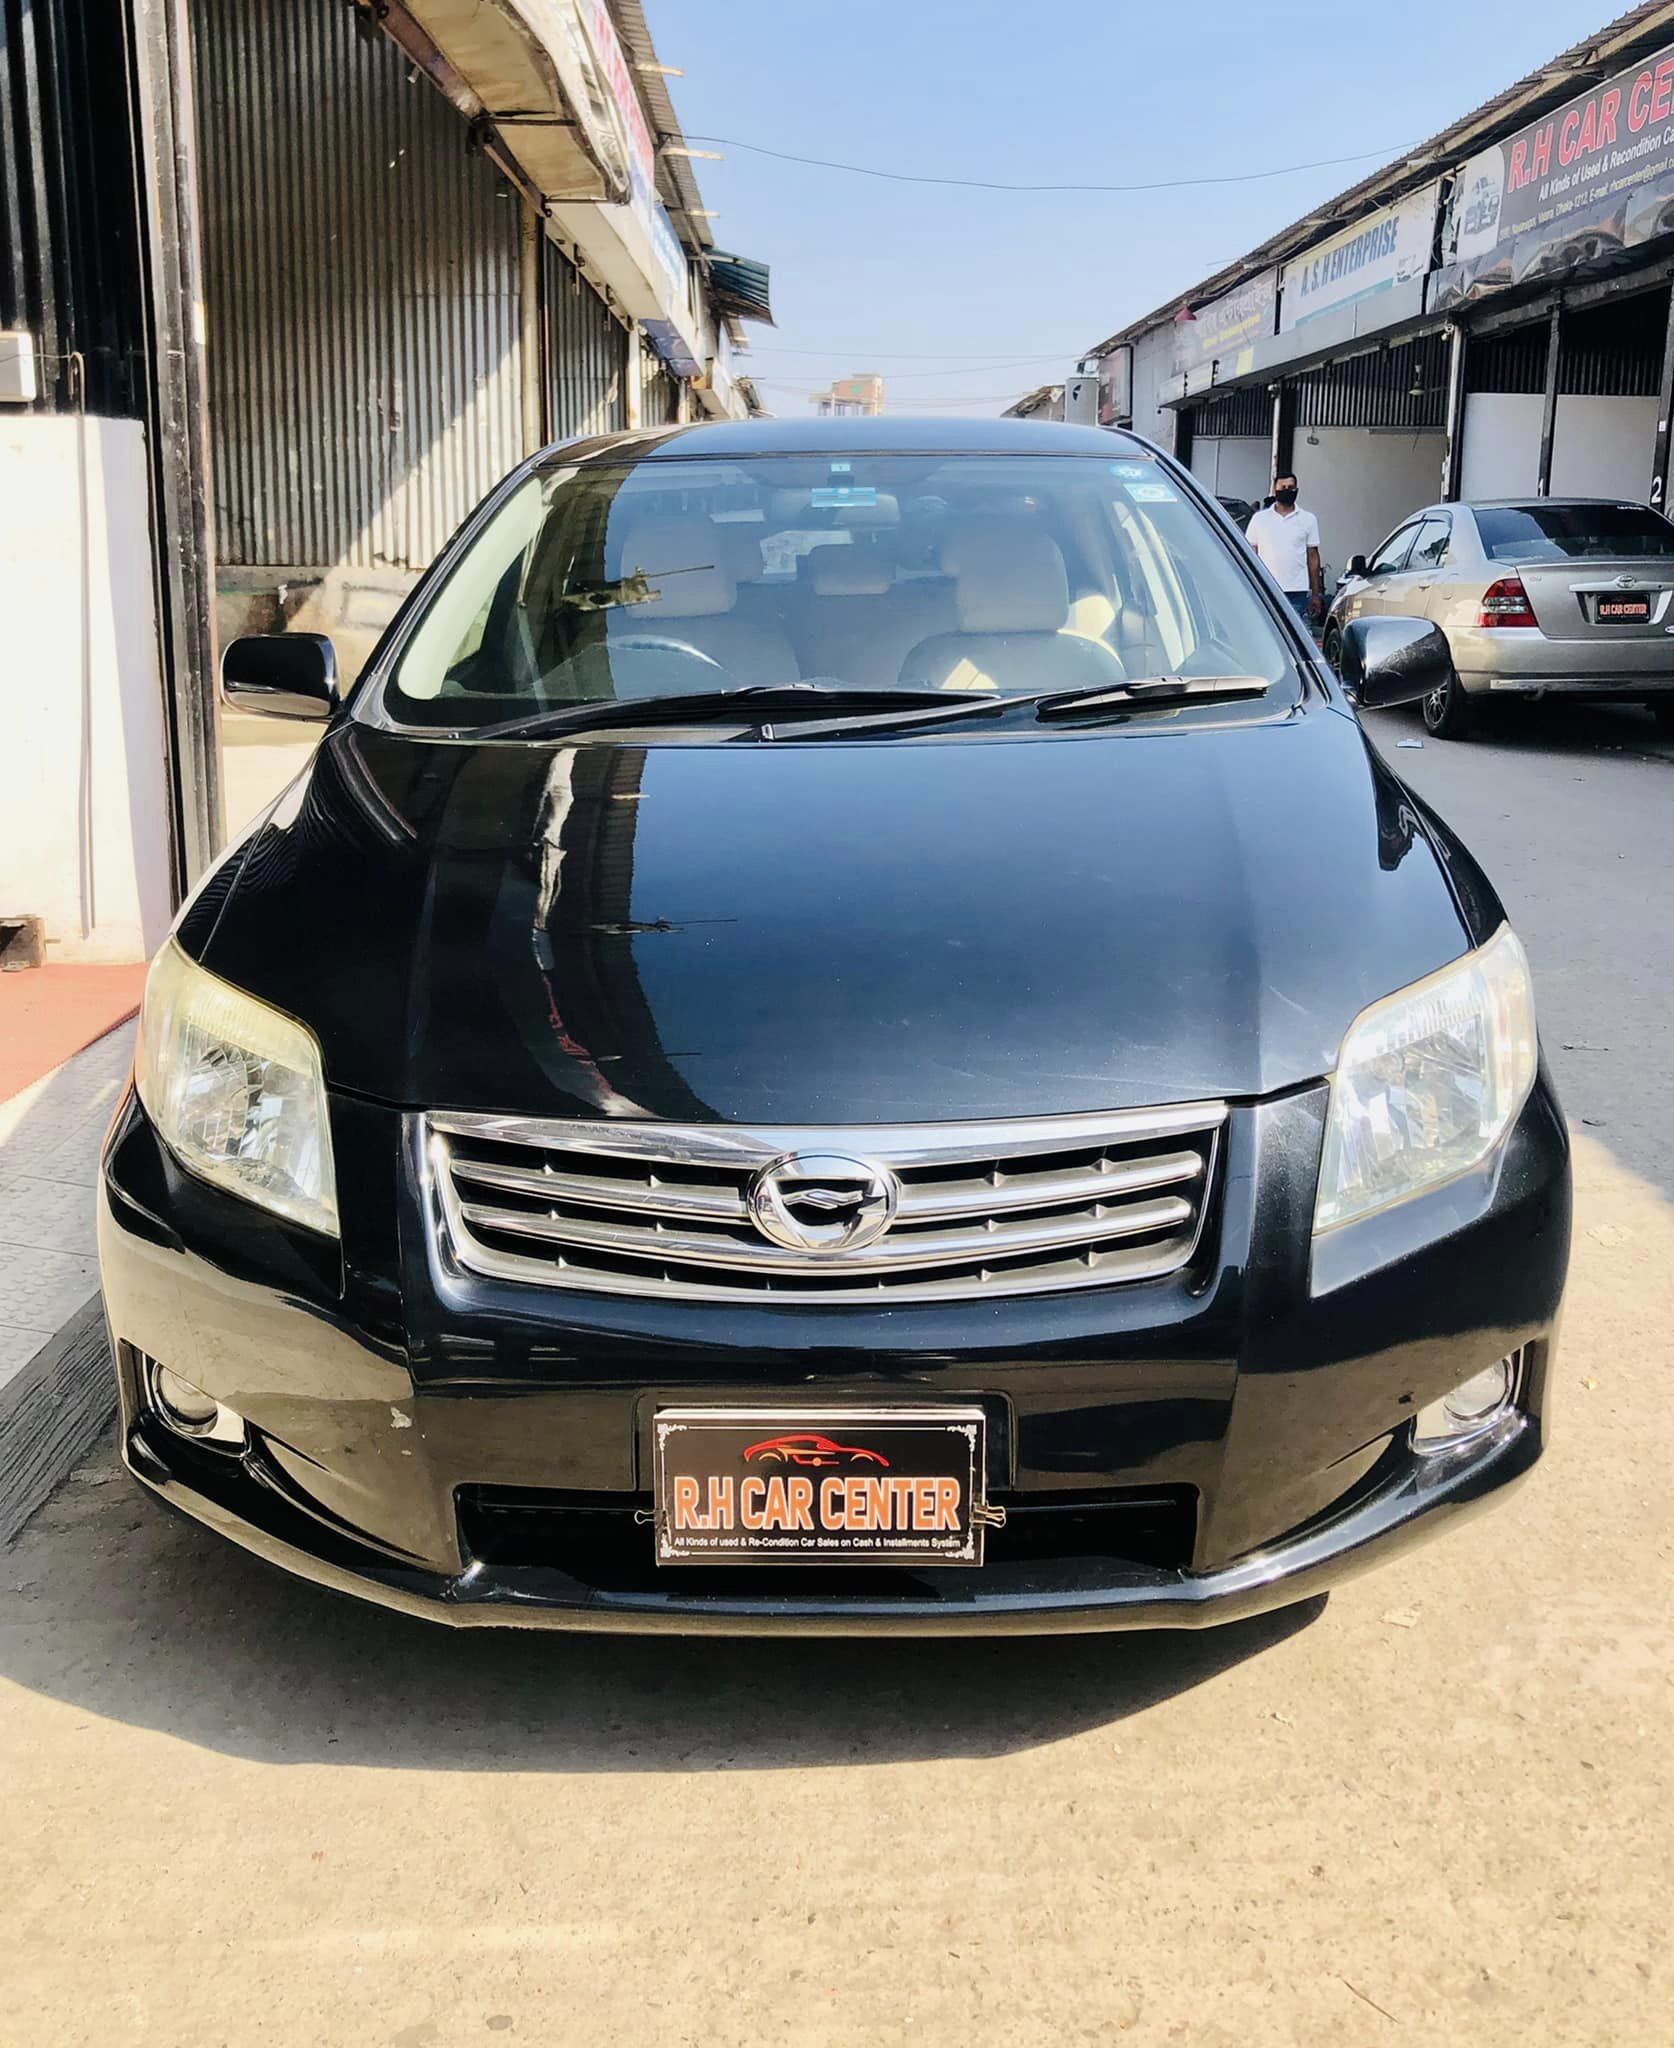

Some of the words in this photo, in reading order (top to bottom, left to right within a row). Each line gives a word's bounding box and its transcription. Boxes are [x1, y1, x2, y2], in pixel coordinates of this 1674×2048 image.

[1508, 123, 1554, 193] R.H
[1558, 88, 1621, 167] CAR
[1628, 57, 1674, 133] CE
[1538, 181, 1549, 201] All
[1549, 173, 1570, 196] Kinds
[1571, 167, 1580, 187] of
[1581, 158, 1601, 182] Used
[1602, 154, 1609, 172] &
[1609, 134, 1661, 169] Recondition
[1330, 215, 1400, 282] ENTERPRISE
[1651, 475, 1662, 503] 2
[674, 1476, 734, 1531] R.H
[740, 1476, 815, 1531] CAR
[820, 1476, 962, 1531] CENTER
[673, 1537, 685, 1547] All
[686, 1537, 708, 1547] Kinds
[709, 1537, 718, 1547] of
[719, 1537, 739, 1547] used
[740, 1537, 747, 1547] &
[748, 1537, 799, 1547] Re-Condition
[800, 1537, 815, 1547] Car
[817, 1537, 839, 1547] Sales
[840, 1539, 851, 1547] on
[852, 1537, 873, 1547] Cash
[875, 1537, 882, 1547] &
[883, 1537, 929, 1547] Installments
[931, 1537, 960, 1549] System
